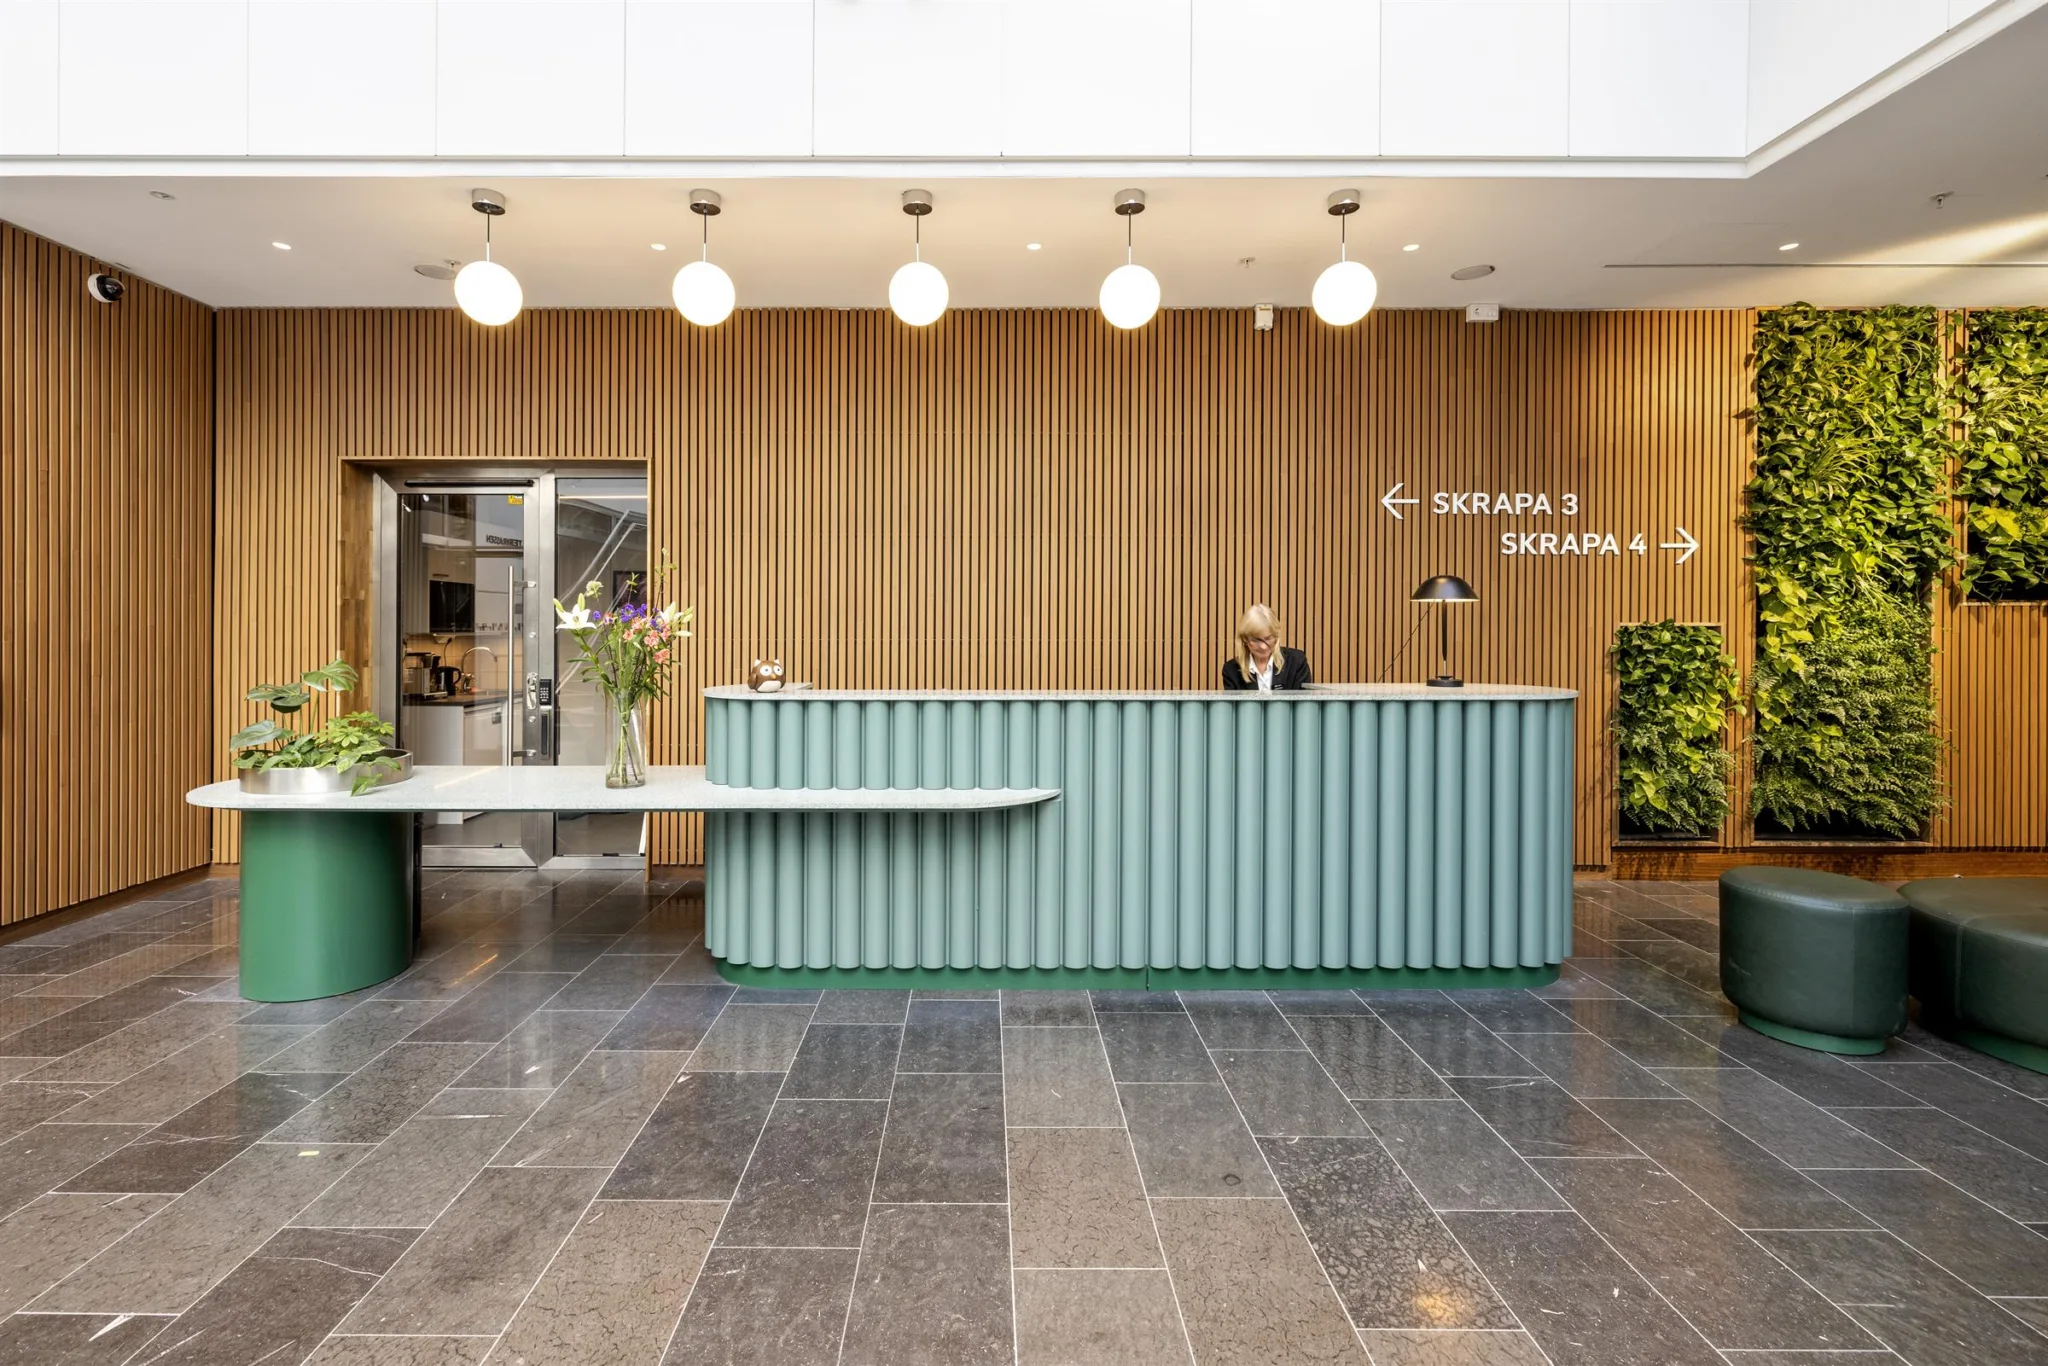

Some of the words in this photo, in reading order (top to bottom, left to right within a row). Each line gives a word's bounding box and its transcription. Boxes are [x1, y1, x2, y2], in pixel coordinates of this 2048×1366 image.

[1433, 492, 1552, 515] SKRAPA
[1561, 492, 1579, 515] 3
[1501, 532, 1620, 555] SKRAPA
[1629, 532, 1647, 555] 4
